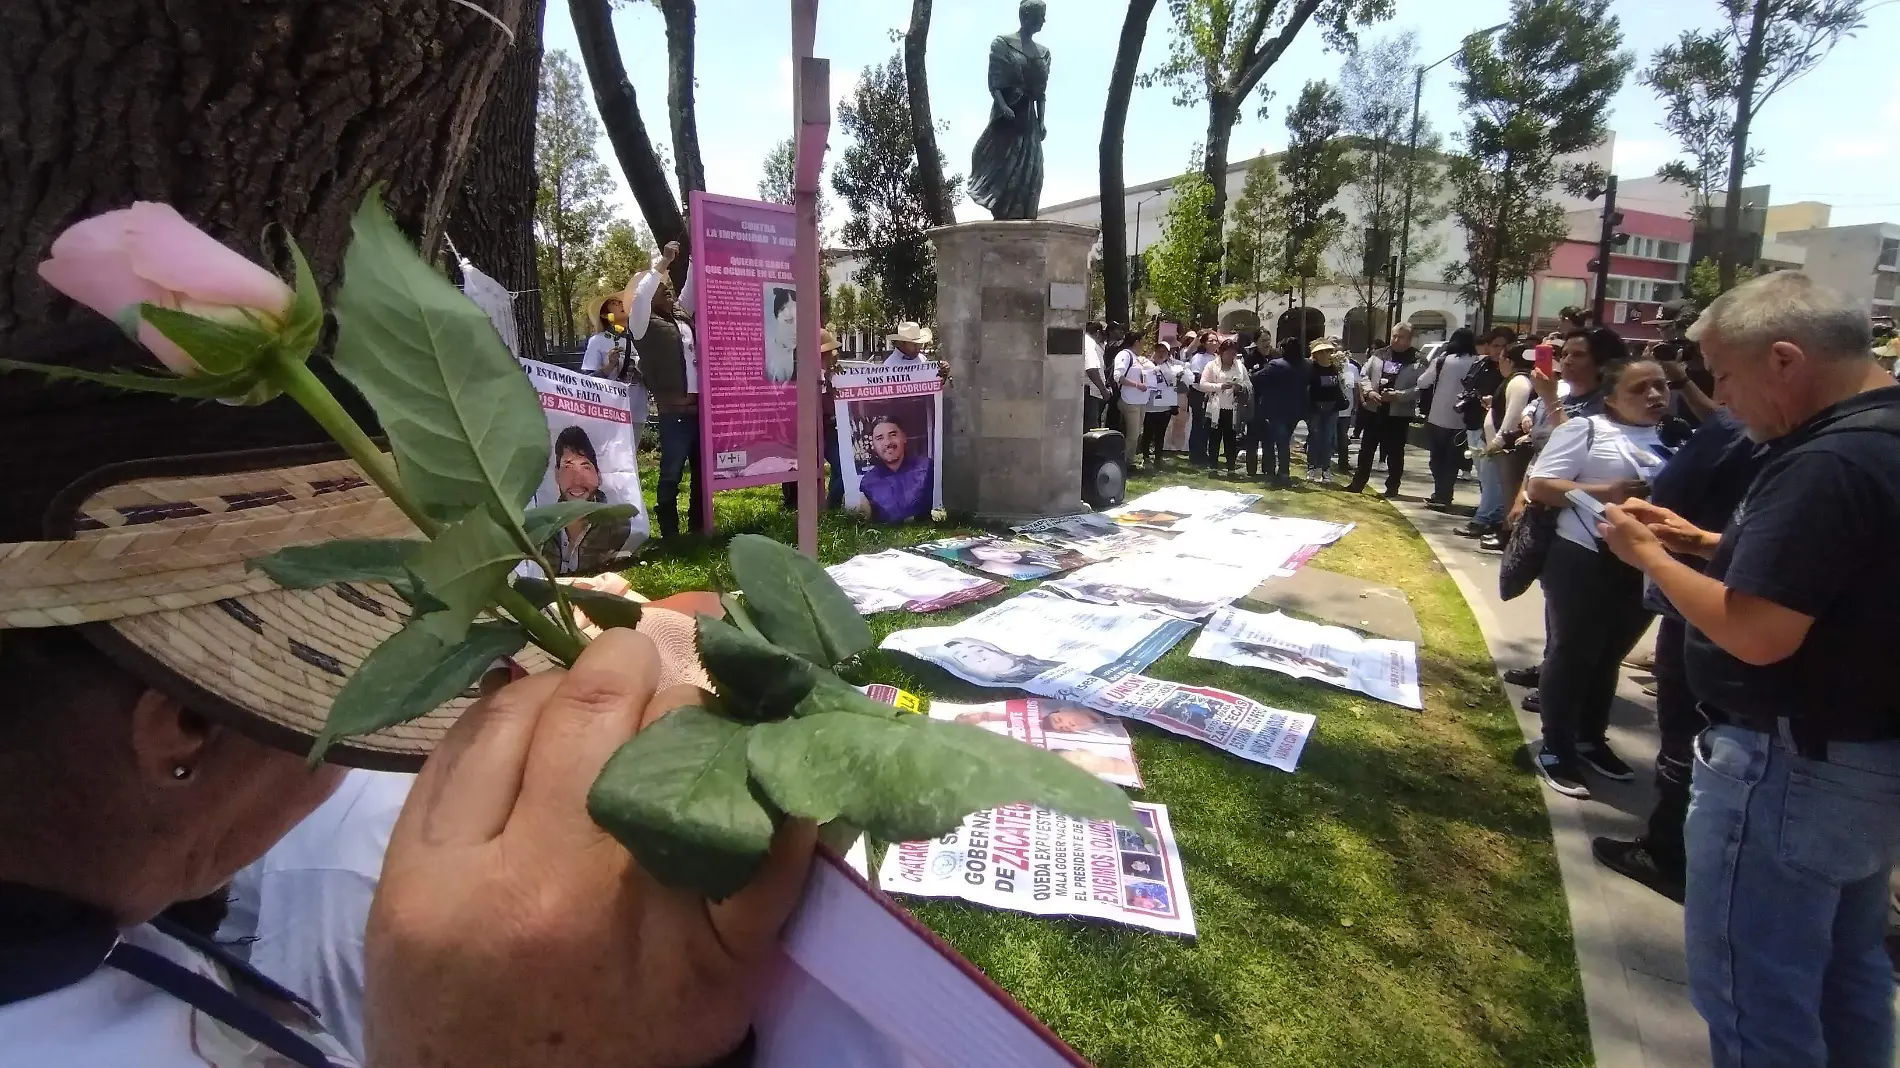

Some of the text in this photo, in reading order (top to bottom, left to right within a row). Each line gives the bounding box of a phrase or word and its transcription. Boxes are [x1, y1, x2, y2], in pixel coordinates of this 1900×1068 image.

[706, 228, 797, 247] LA IMPUNIDAD Y OLVI
[741, 221, 776, 234] CONTRA
[705, 264, 722, 275] QUE
[723, 266, 756, 277] OCURRE
[757, 268, 767, 278] EN
[768, 270, 776, 279] EL
[850, 365, 890, 375] ESTAMOS
[893, 360, 940, 373] COMPLETOS
[867, 374, 911, 385] NOS FALTA
[536, 366, 577, 386] ESTAMOS
[580, 378, 627, 398] COMPLETOS
[556, 385, 601, 403] NOS FALTA
[836, 381, 941, 398] UEL AGUILAR RODRIGUEZ
[539, 392, 627, 422] ÚS ARIAS IGLESIAS
[1211, 700, 1248, 742] ZACATECAS
[964, 807, 993, 886] GOBERNA
[992, 800, 1032, 893] DE ZACATEC
[1033, 809, 1053, 901] QUEDA EXPUESTO
[1055, 813, 1068, 897] MALA GOBERNACIO
[1072, 836, 1087, 888] PRESIDENTE
[1074, 892, 1087, 902] EL
